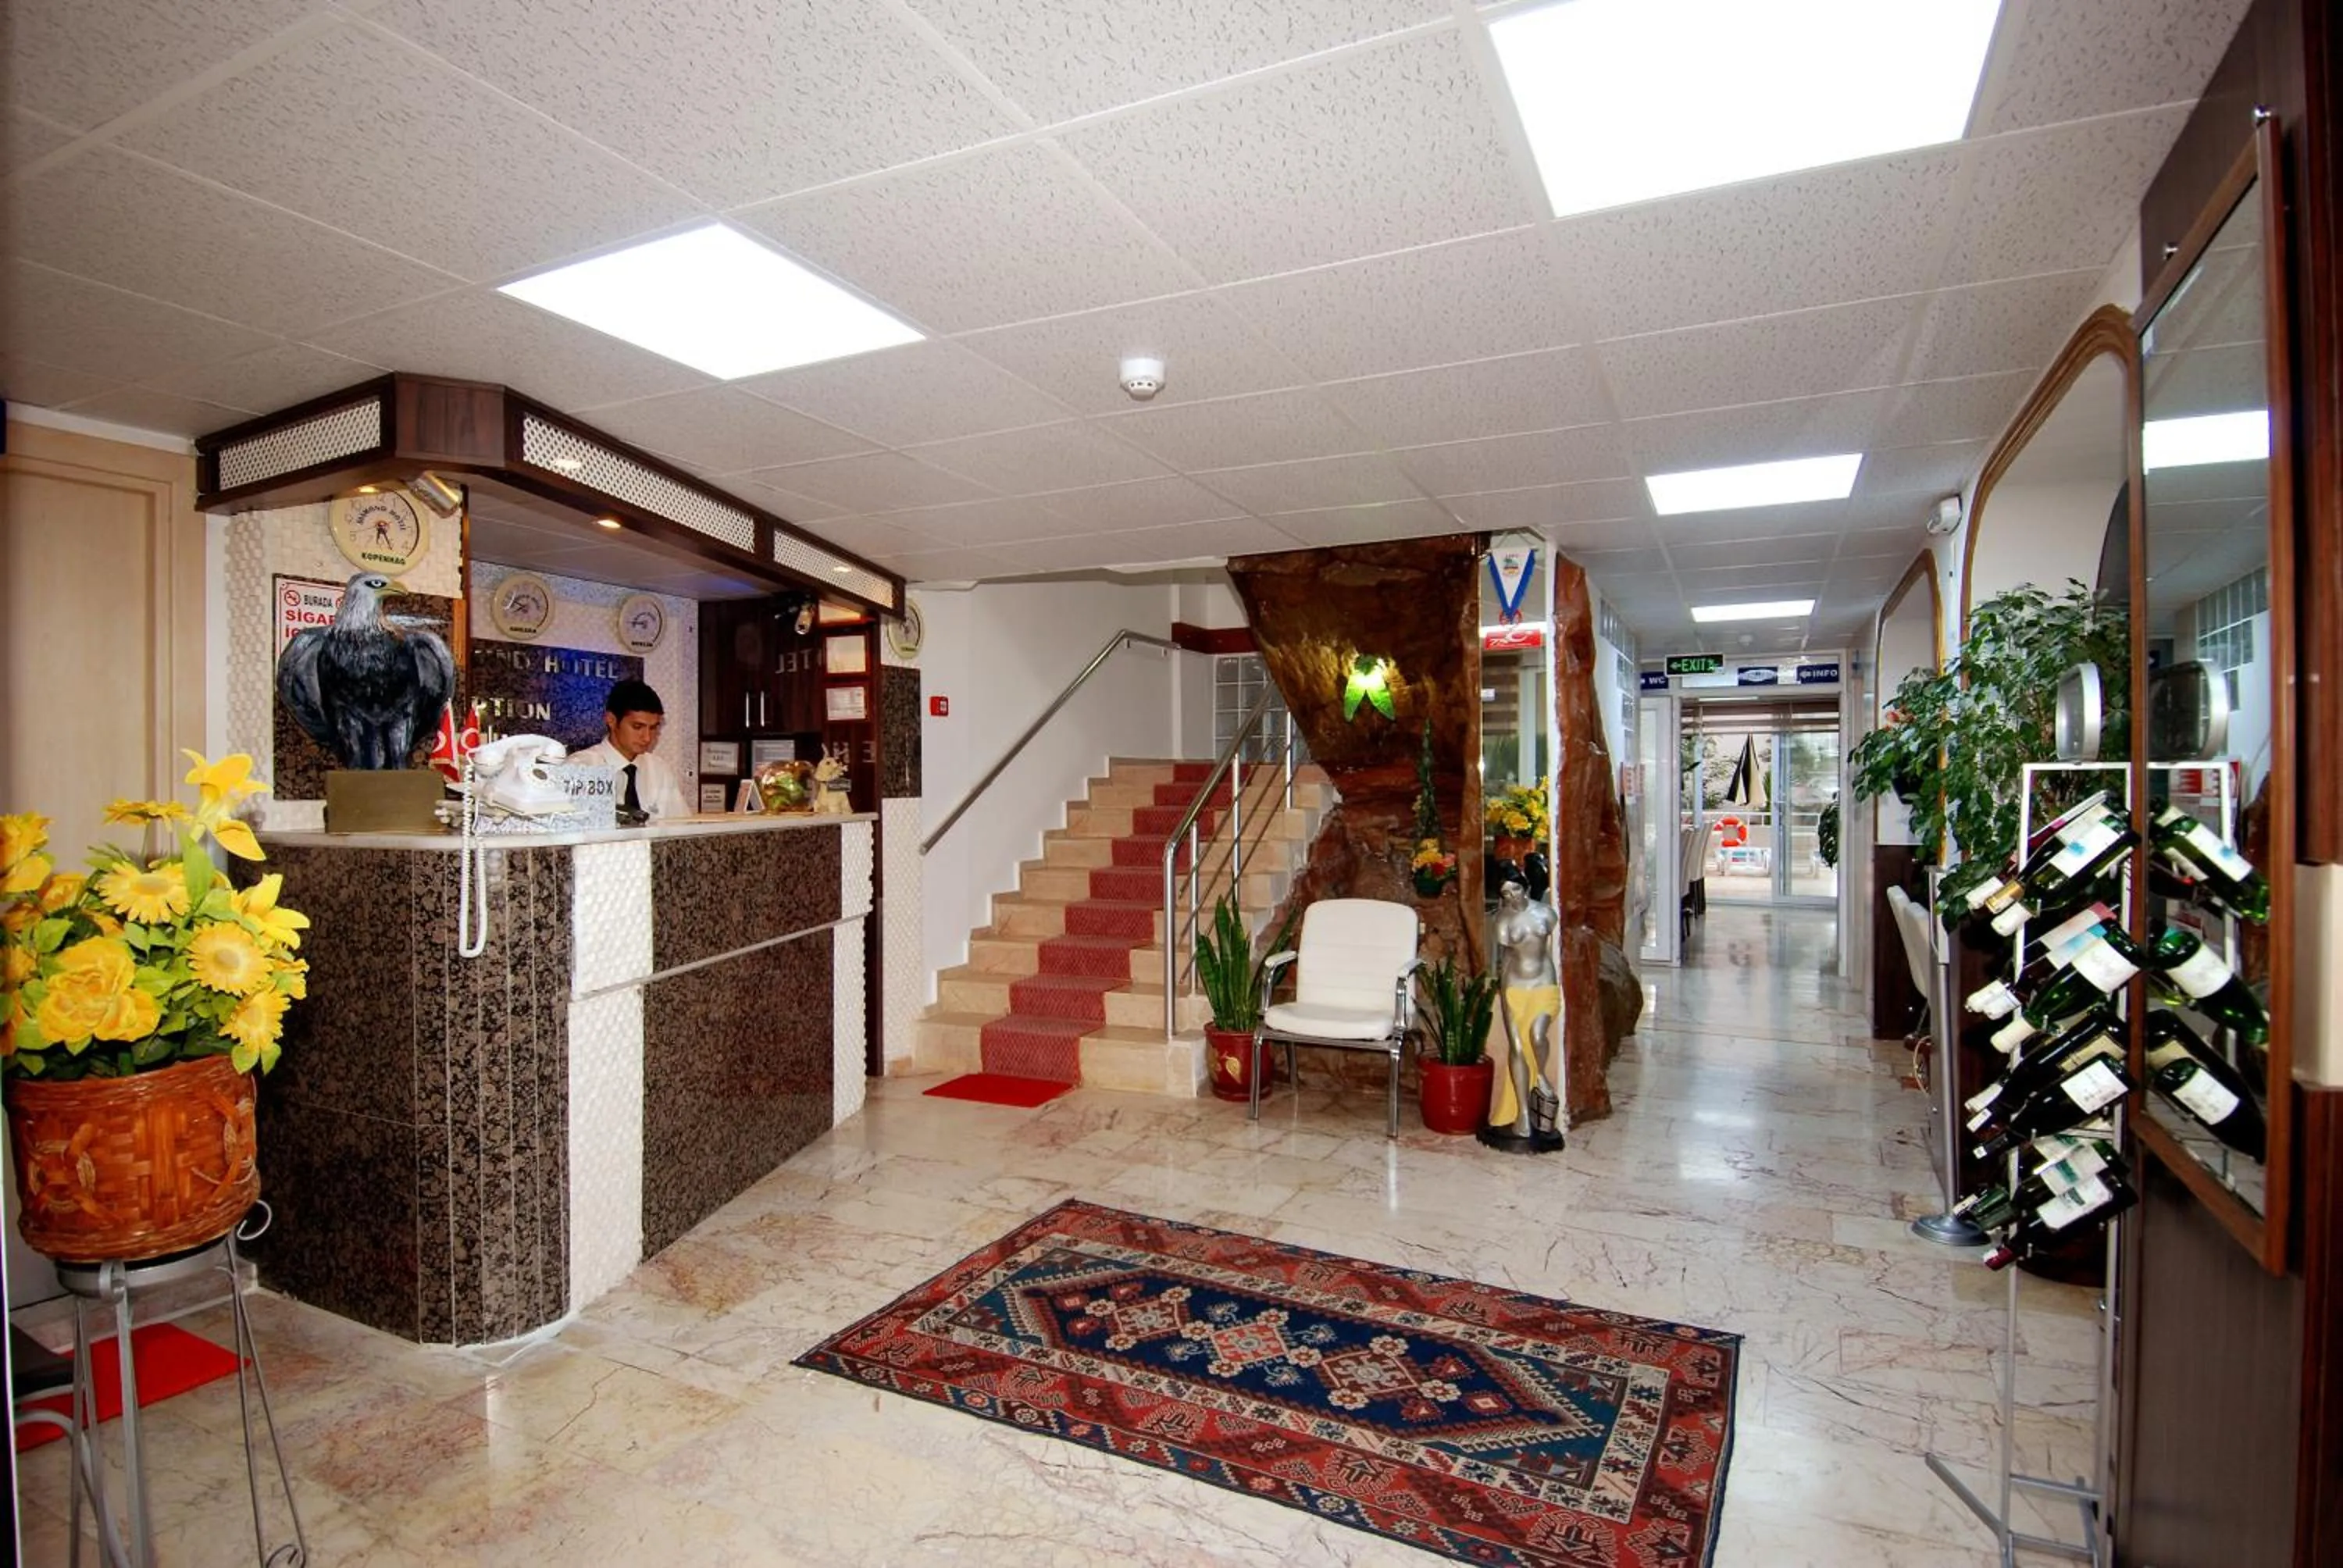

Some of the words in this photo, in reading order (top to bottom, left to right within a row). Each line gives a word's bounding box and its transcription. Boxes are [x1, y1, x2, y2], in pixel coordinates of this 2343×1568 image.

[304, 594, 333, 608] BURADA
[286, 608, 336, 626] SİGAR
[1681, 658, 1706, 672] EXIT
[1813, 669, 1838, 679] INFO
[588, 780, 613, 796] BOX
